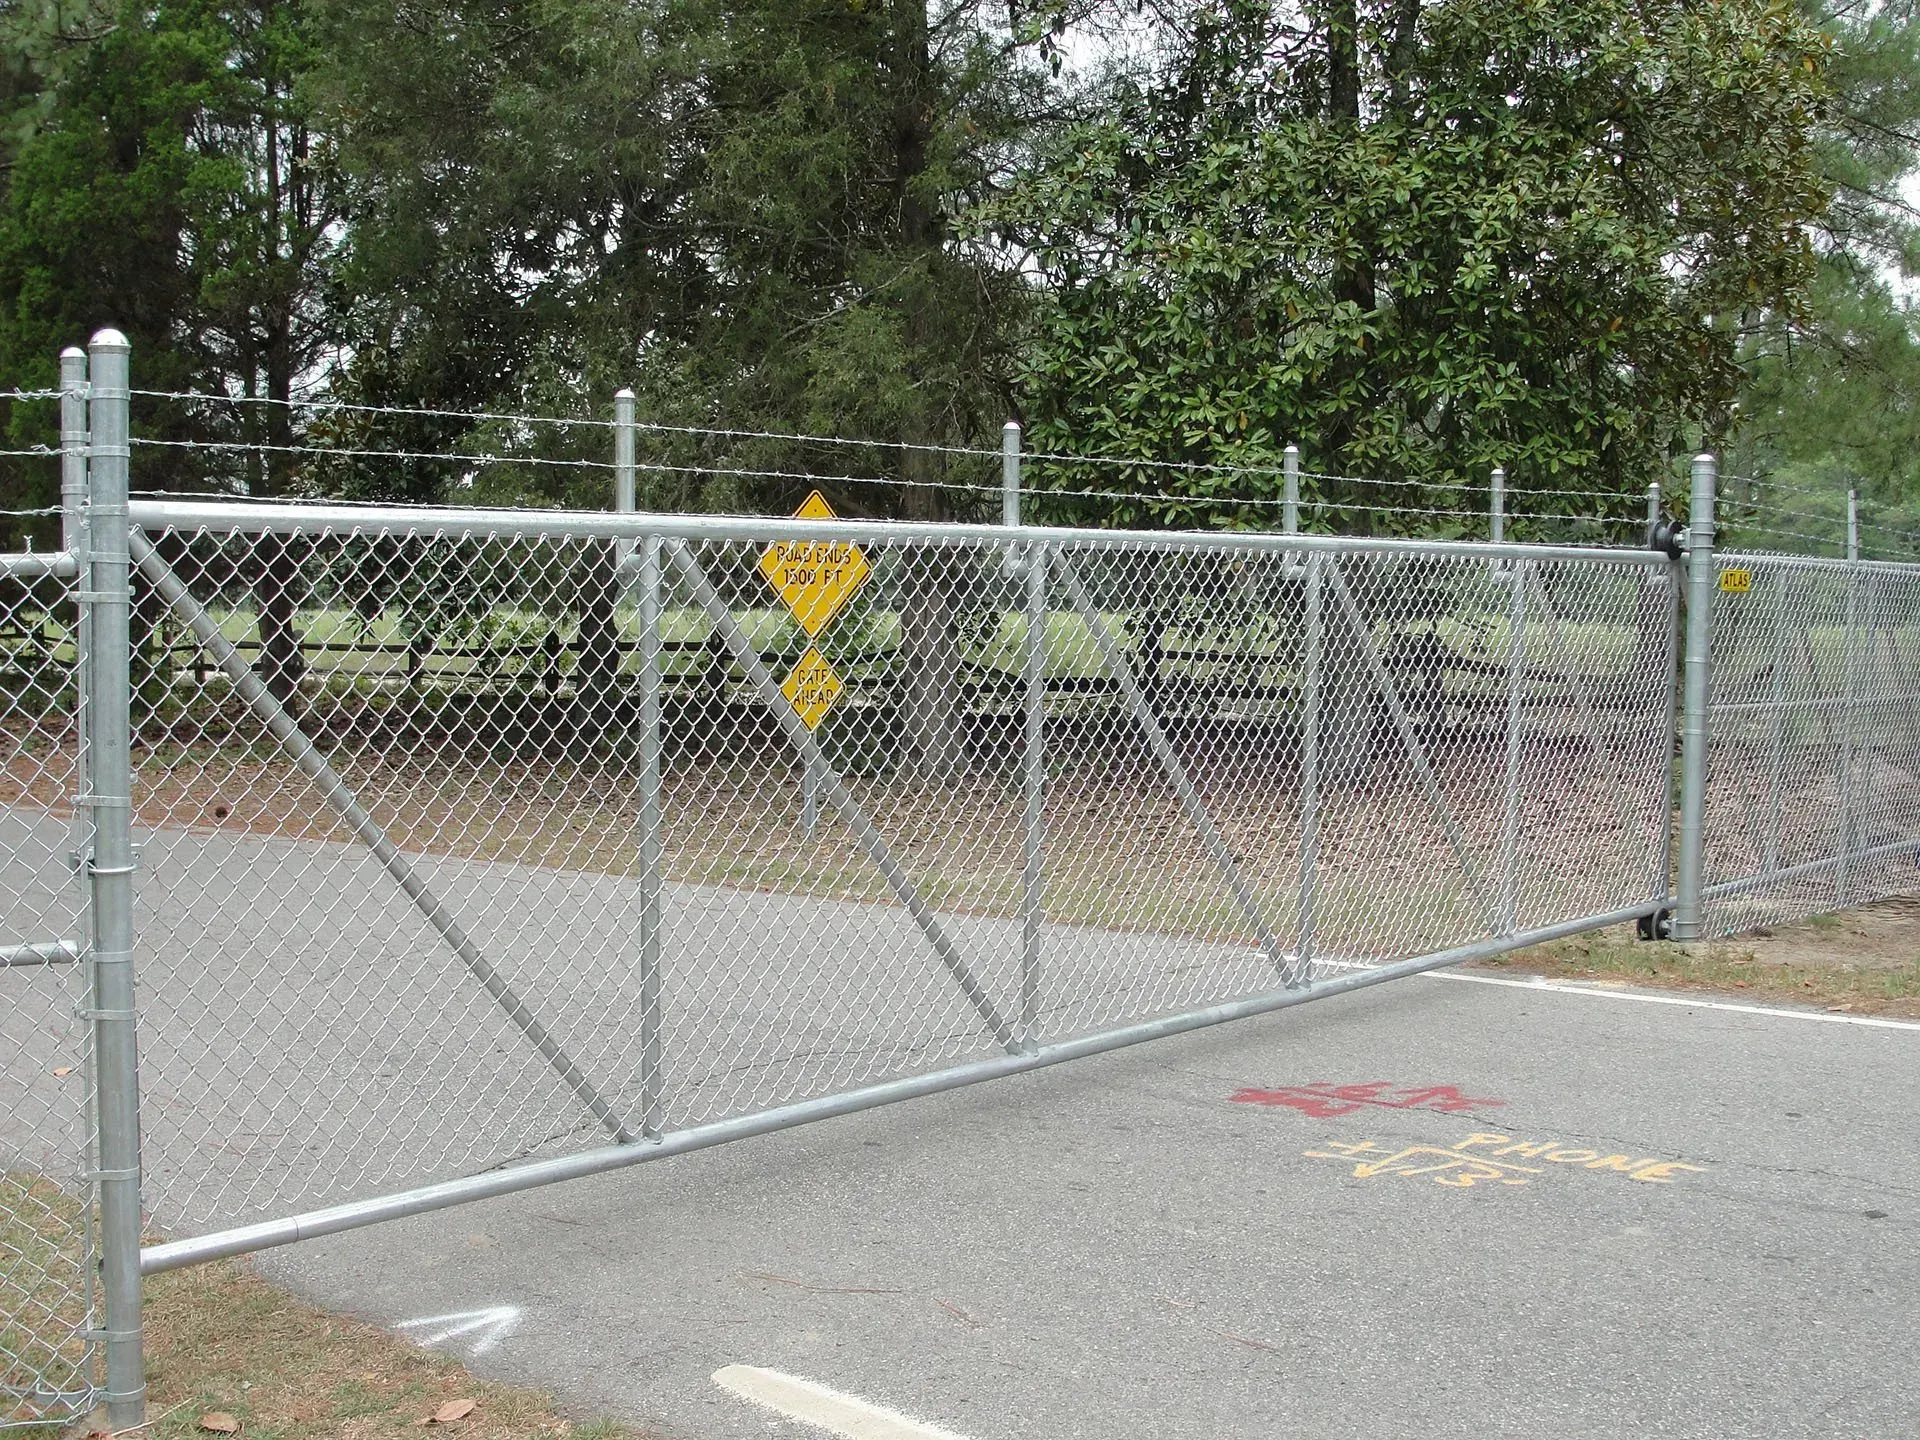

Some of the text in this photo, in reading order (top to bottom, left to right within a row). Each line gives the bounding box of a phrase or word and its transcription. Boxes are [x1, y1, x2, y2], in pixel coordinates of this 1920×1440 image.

[777, 546, 851, 564] ROAD ENDS
[824, 570, 842, 586] FT
[1723, 573, 1748, 587] ATLAS
[798, 669, 828, 685] GATE
[793, 689, 834, 705] AHEAD
[1454, 1132, 1707, 1184] PHONE
